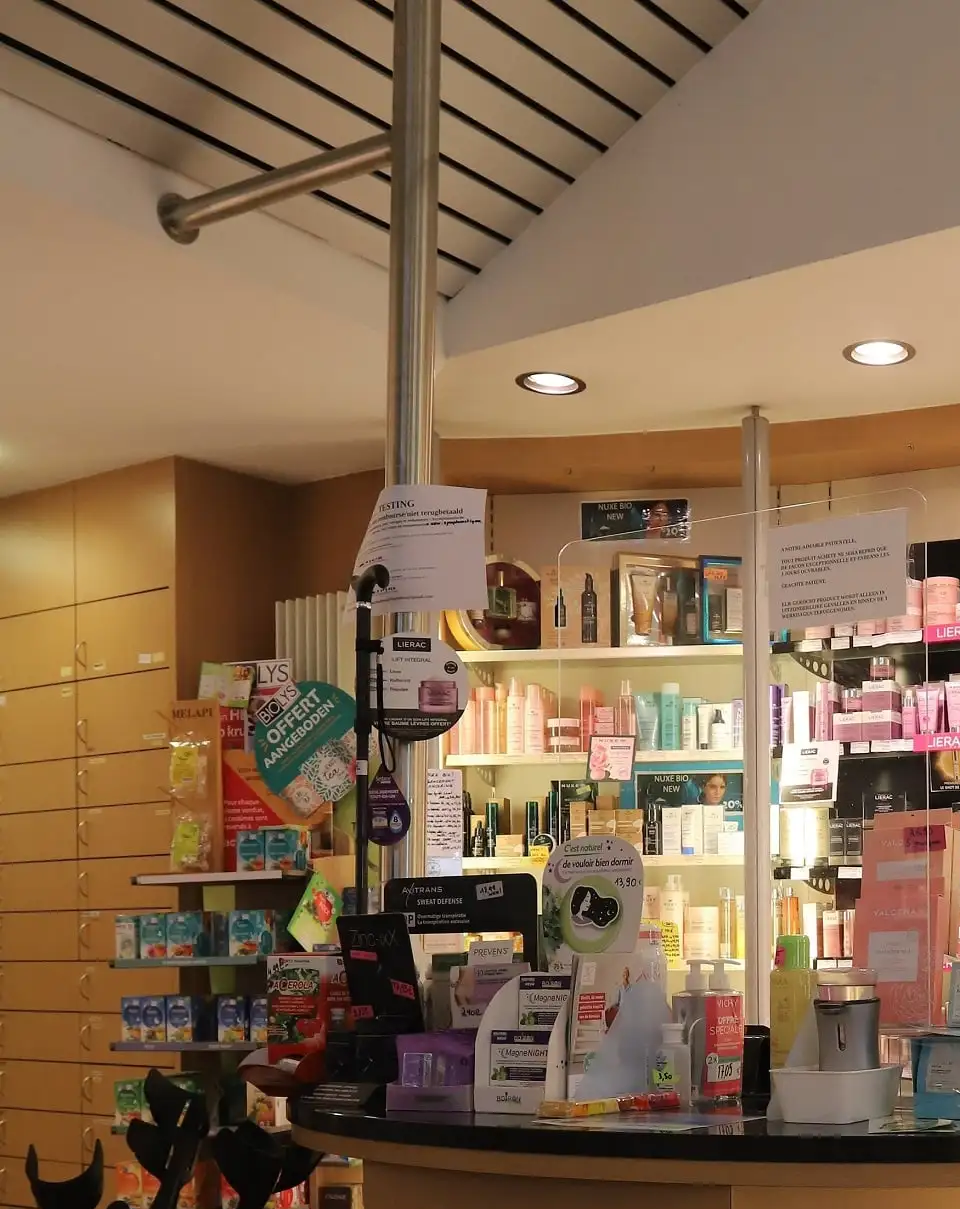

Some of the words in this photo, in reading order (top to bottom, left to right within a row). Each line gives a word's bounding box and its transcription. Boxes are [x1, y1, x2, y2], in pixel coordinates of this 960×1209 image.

[598, 503, 618, 511] NUXE
[606, 513, 624, 521] NEW
[397, 641, 427, 649] LIERAC
[256, 664, 289, 685] LYS
[257, 686, 298, 724] BIOLYS
[172, 707, 213, 720] MELAPI
[266, 688, 323, 745] OFFERT
[263, 699, 335, 769] AANGEBODEN
[654, 775, 674, 783] NUXE
[676, 774, 689, 783] BIO
[662, 785, 681, 793] NEW
[564, 843, 580, 853] C'est
[580, 843, 603, 851] naturel
[562, 860, 572, 869] de
[572, 859, 594, 868] vouloir
[595, 858, 610, 867] bien
[611, 858, 634, 866] dormir
[417, 898, 436, 906] SWEAT
[437, 897, 463, 905] DEFENSE
[716, 999, 739, 1008] VICHY
